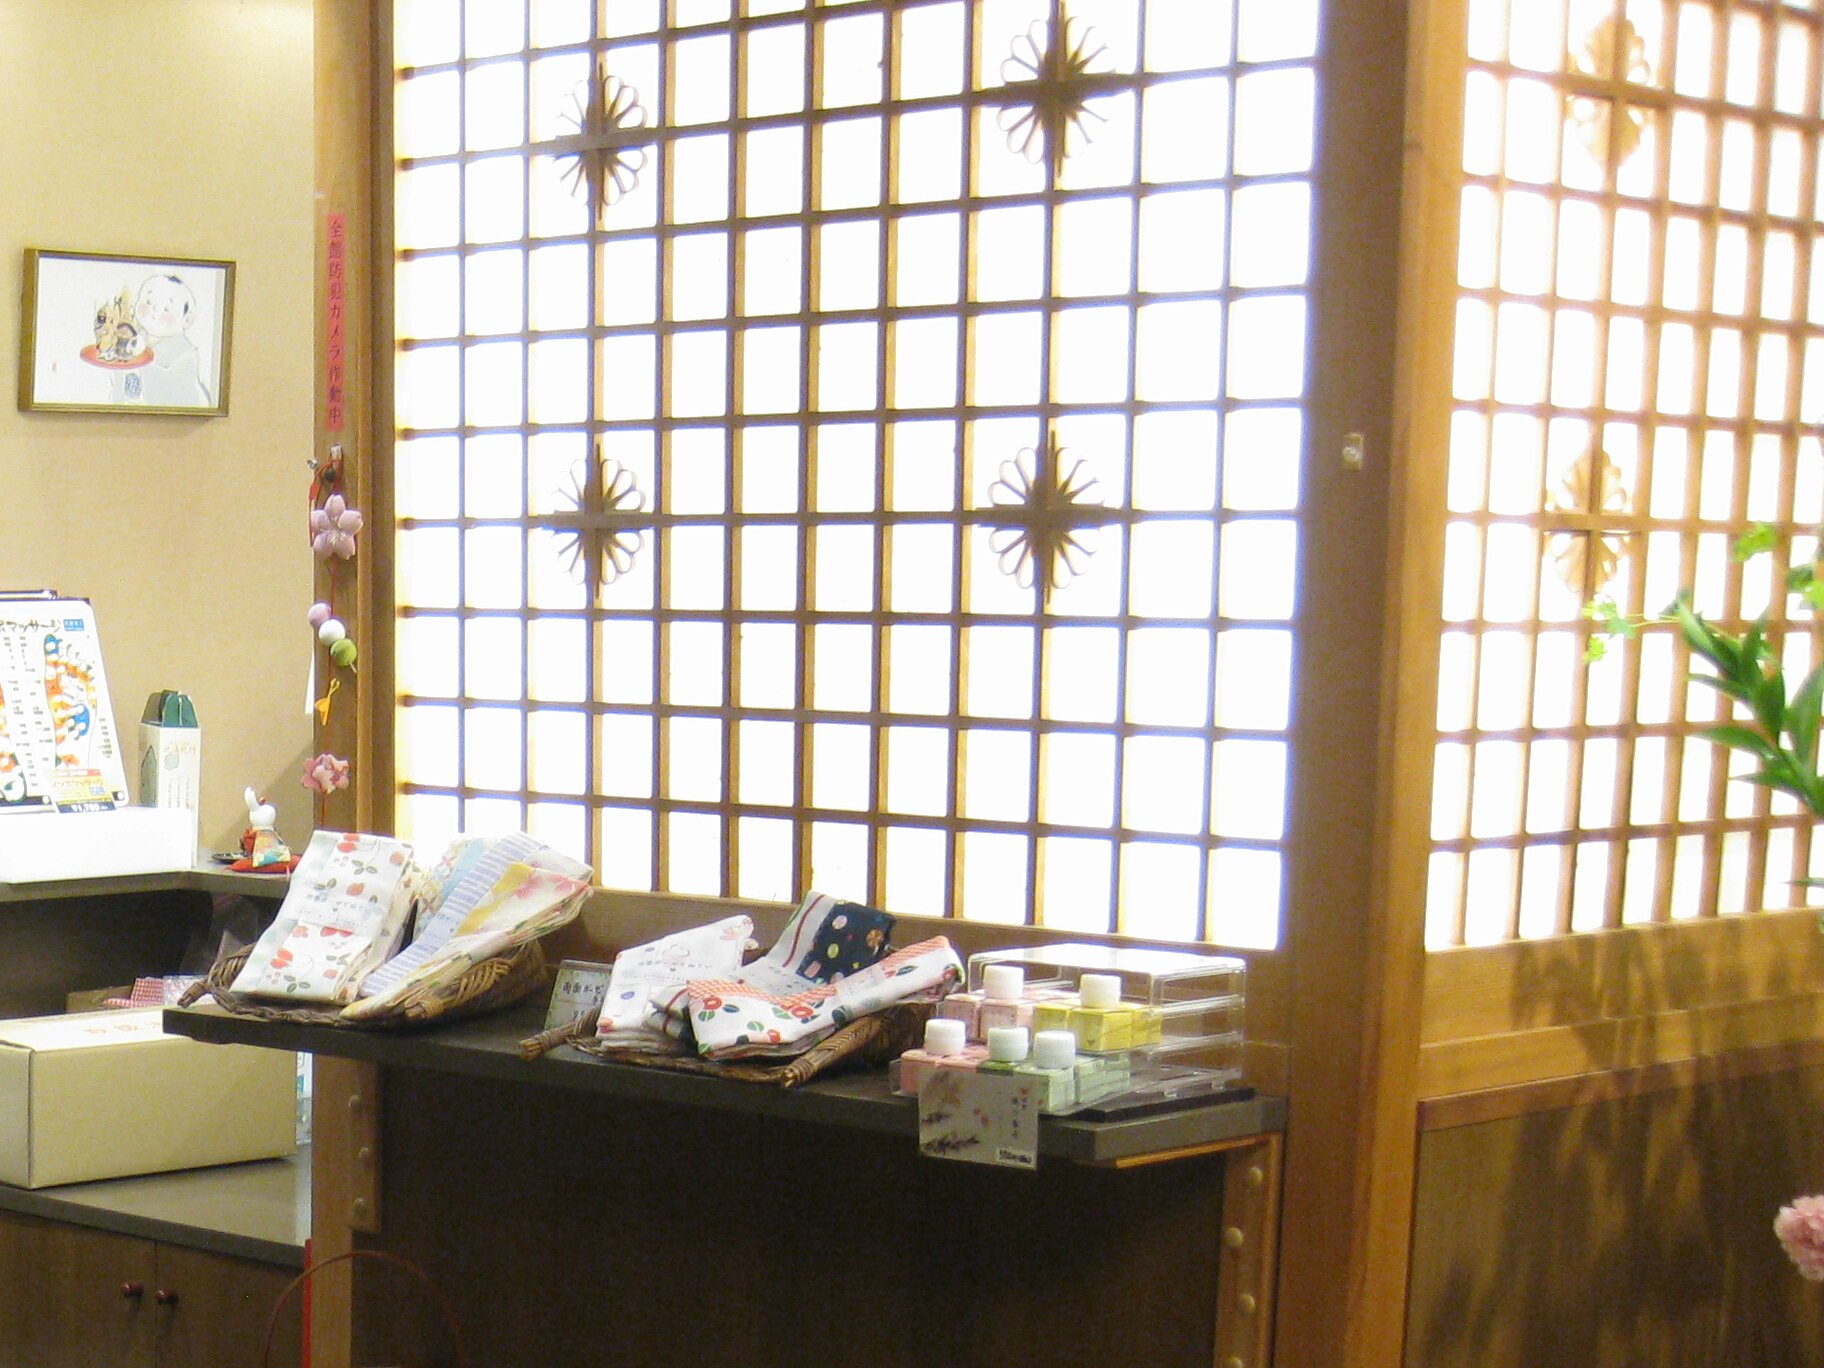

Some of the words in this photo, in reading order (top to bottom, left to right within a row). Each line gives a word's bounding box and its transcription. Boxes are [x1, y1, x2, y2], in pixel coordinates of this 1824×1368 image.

[328, 220, 342, 424] 全館防犯カメラ作動中
